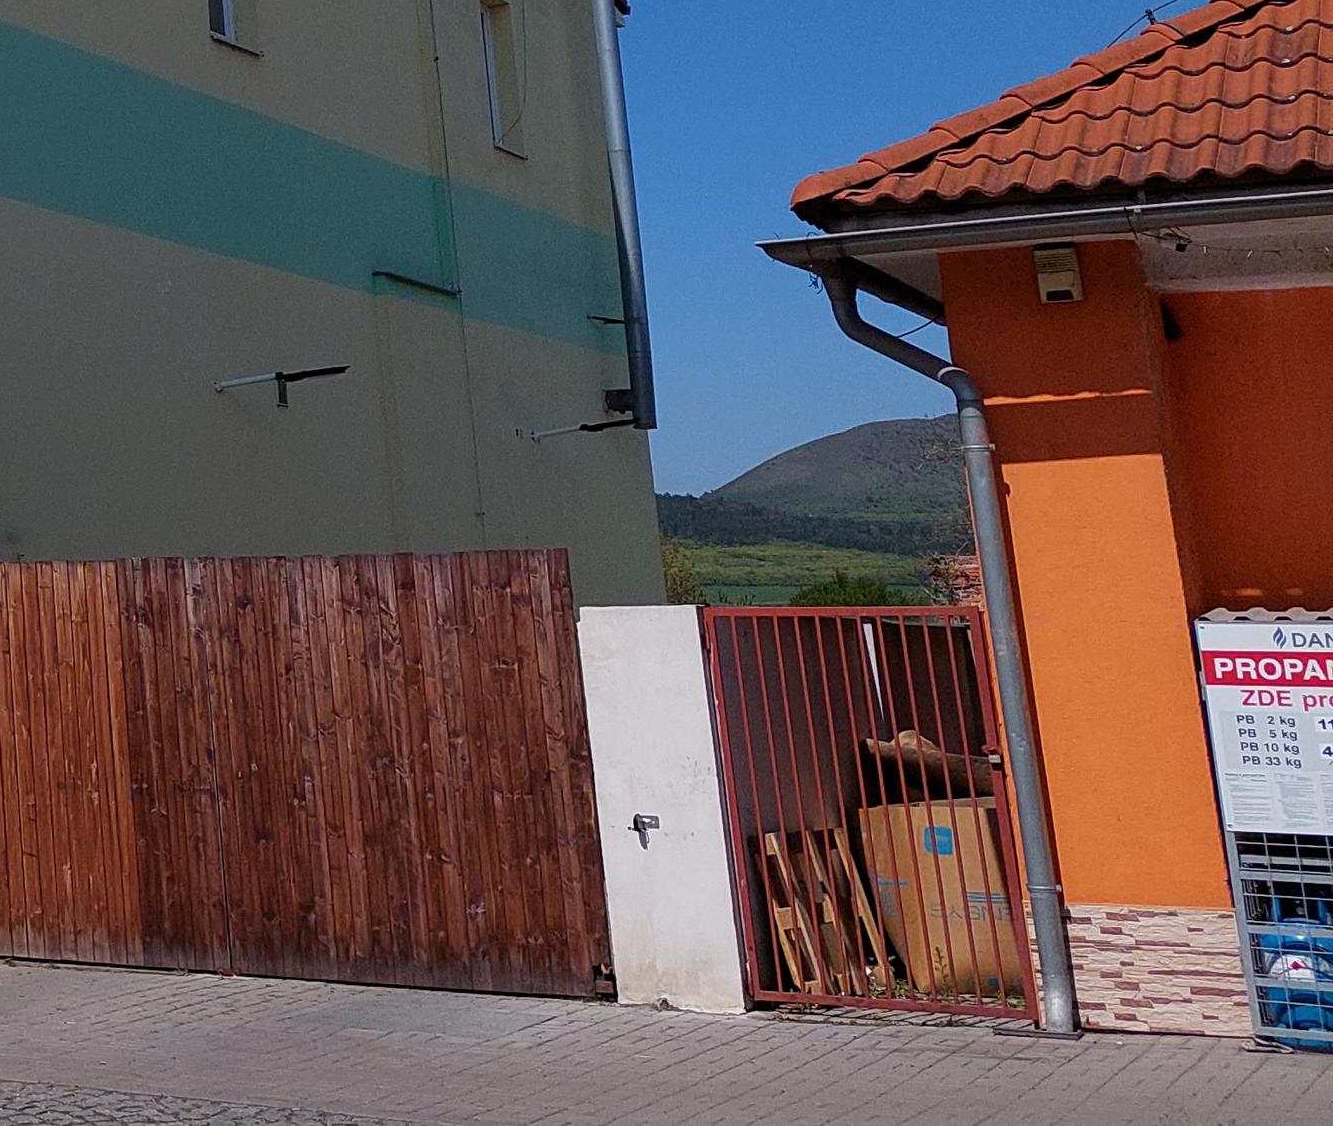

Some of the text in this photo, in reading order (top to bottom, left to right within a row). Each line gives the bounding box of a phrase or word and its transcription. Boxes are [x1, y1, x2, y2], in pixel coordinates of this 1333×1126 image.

[1240, 689, 1294, 707] ZDE
[1236, 714, 1255, 725] PB
[1267, 715, 1276, 725] 2
[1279, 715, 1296, 728] kg
[1238, 728, 1298, 742] PB 5 kg
[1240, 741, 1259, 752] PB
[1264, 742, 1279, 753] 10
[1283, 743, 1300, 755] kg
[1242, 755, 1302, 770] PB 33 kg
